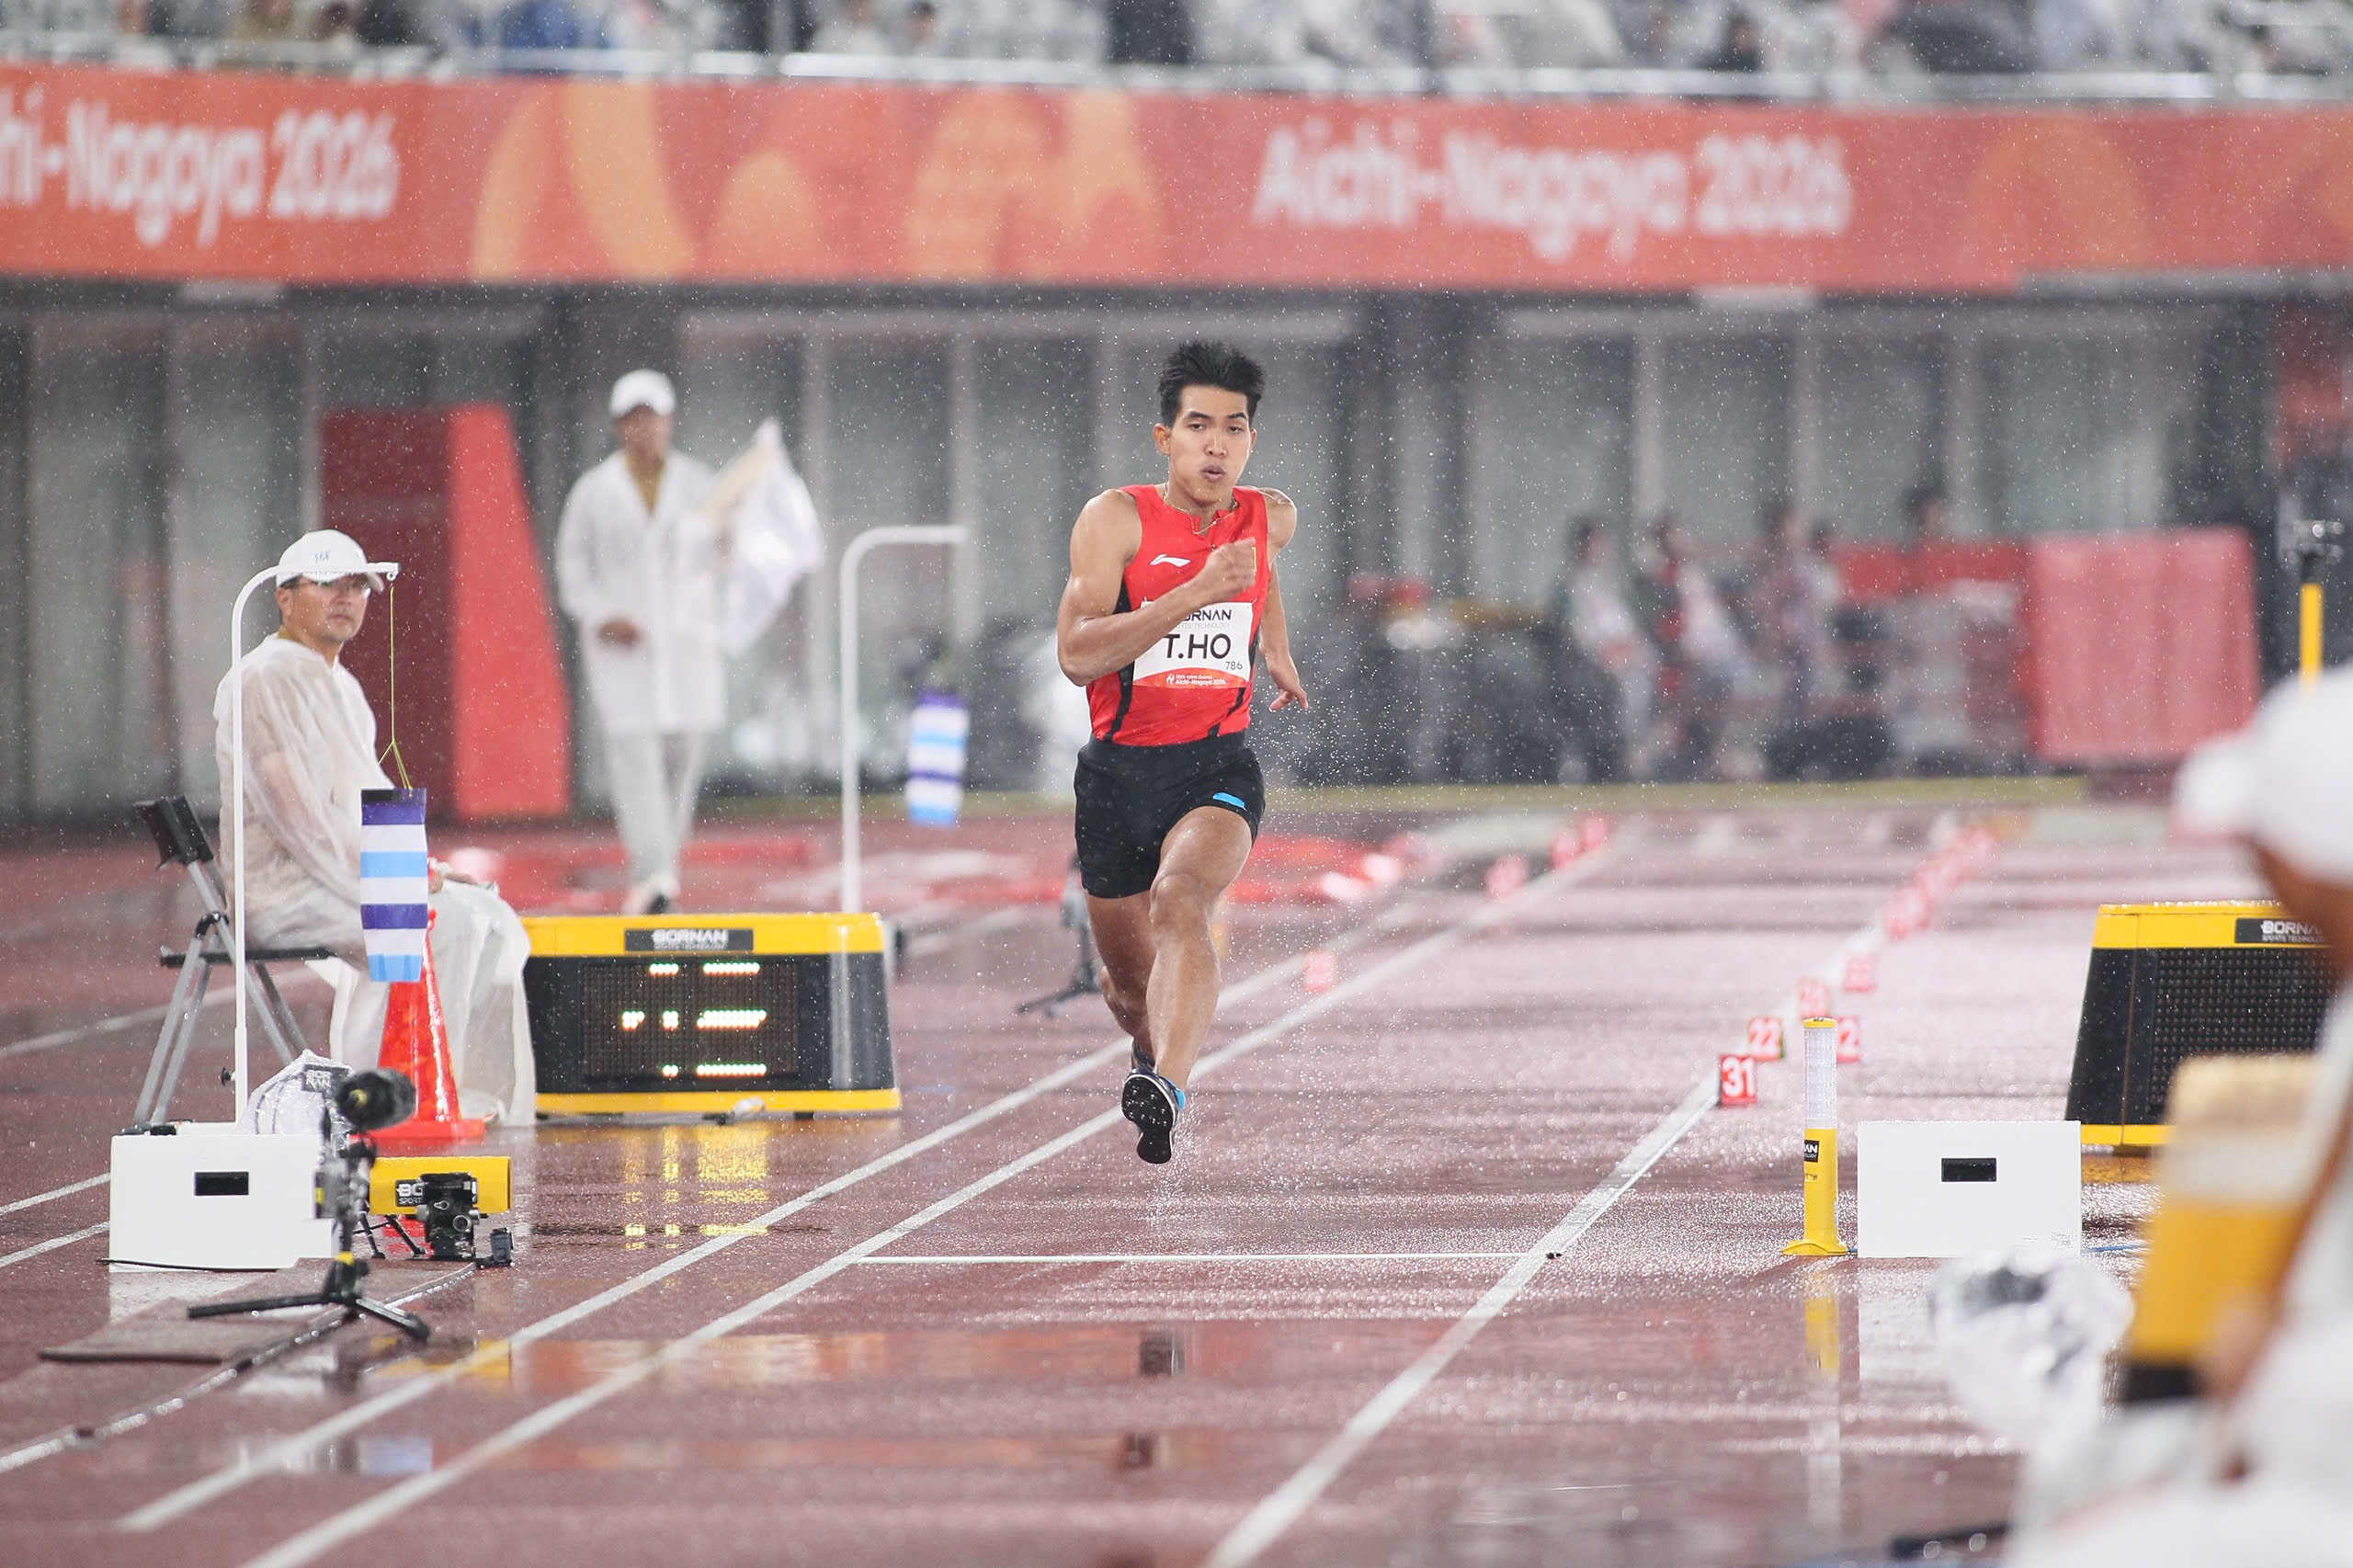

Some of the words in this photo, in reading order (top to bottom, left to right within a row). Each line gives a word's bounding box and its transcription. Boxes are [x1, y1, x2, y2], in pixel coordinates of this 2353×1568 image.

[269, 108, 402, 222] 2026
[1254, 116, 1689, 265] Aichi-Nagoya
[1695, 133, 1855, 237] 2026
[1183, 609, 1232, 621] RNAN
[1162, 633, 1232, 659] T.HO
[1225, 661, 1244, 670] 786
[1176, 678, 1213, 687] Aichi-Nagoya
[1721, 1056, 1756, 1098] 31
